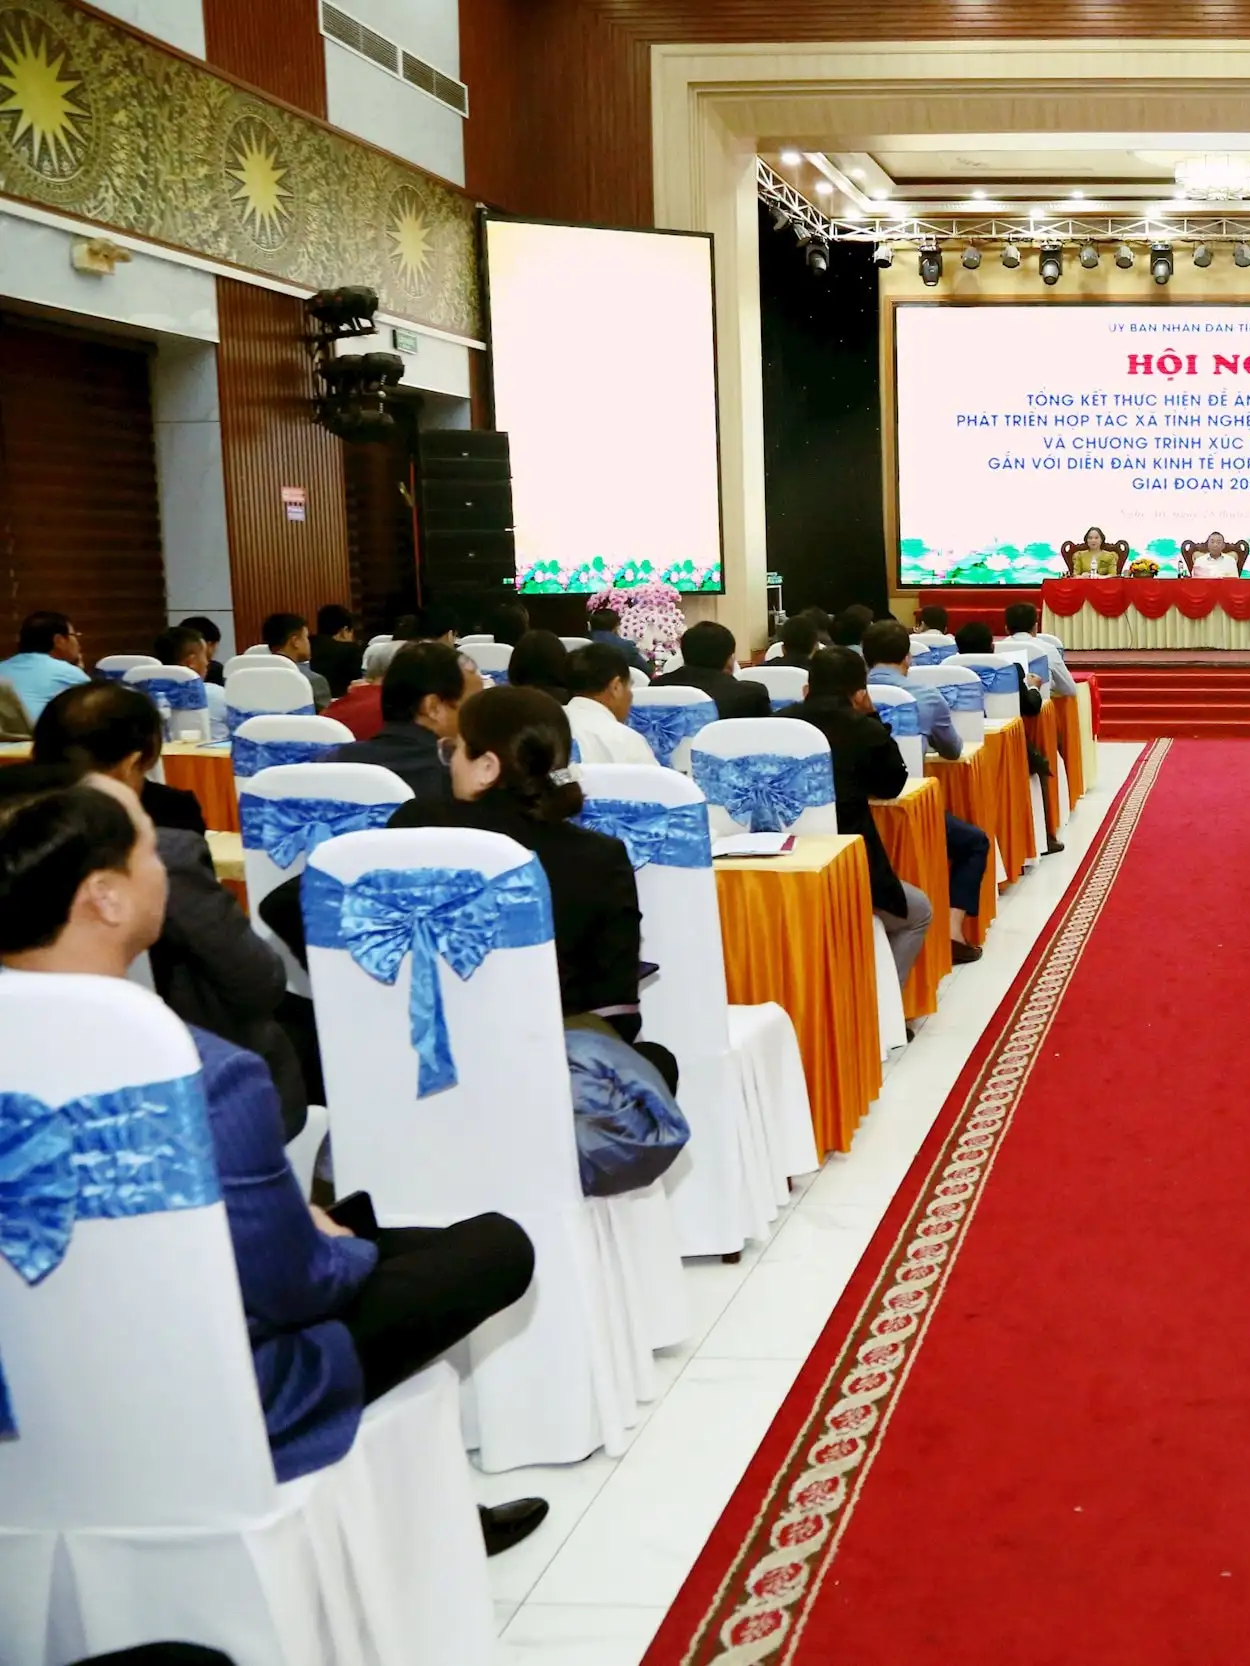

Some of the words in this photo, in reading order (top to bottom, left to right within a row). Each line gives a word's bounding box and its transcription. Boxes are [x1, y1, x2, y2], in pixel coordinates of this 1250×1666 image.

[1130, 323, 1157, 332] BAN
[1127, 347, 1198, 381] HỘI
[1153, 458, 1192, 469] KINH
[1132, 478, 1167, 490] GIAI
